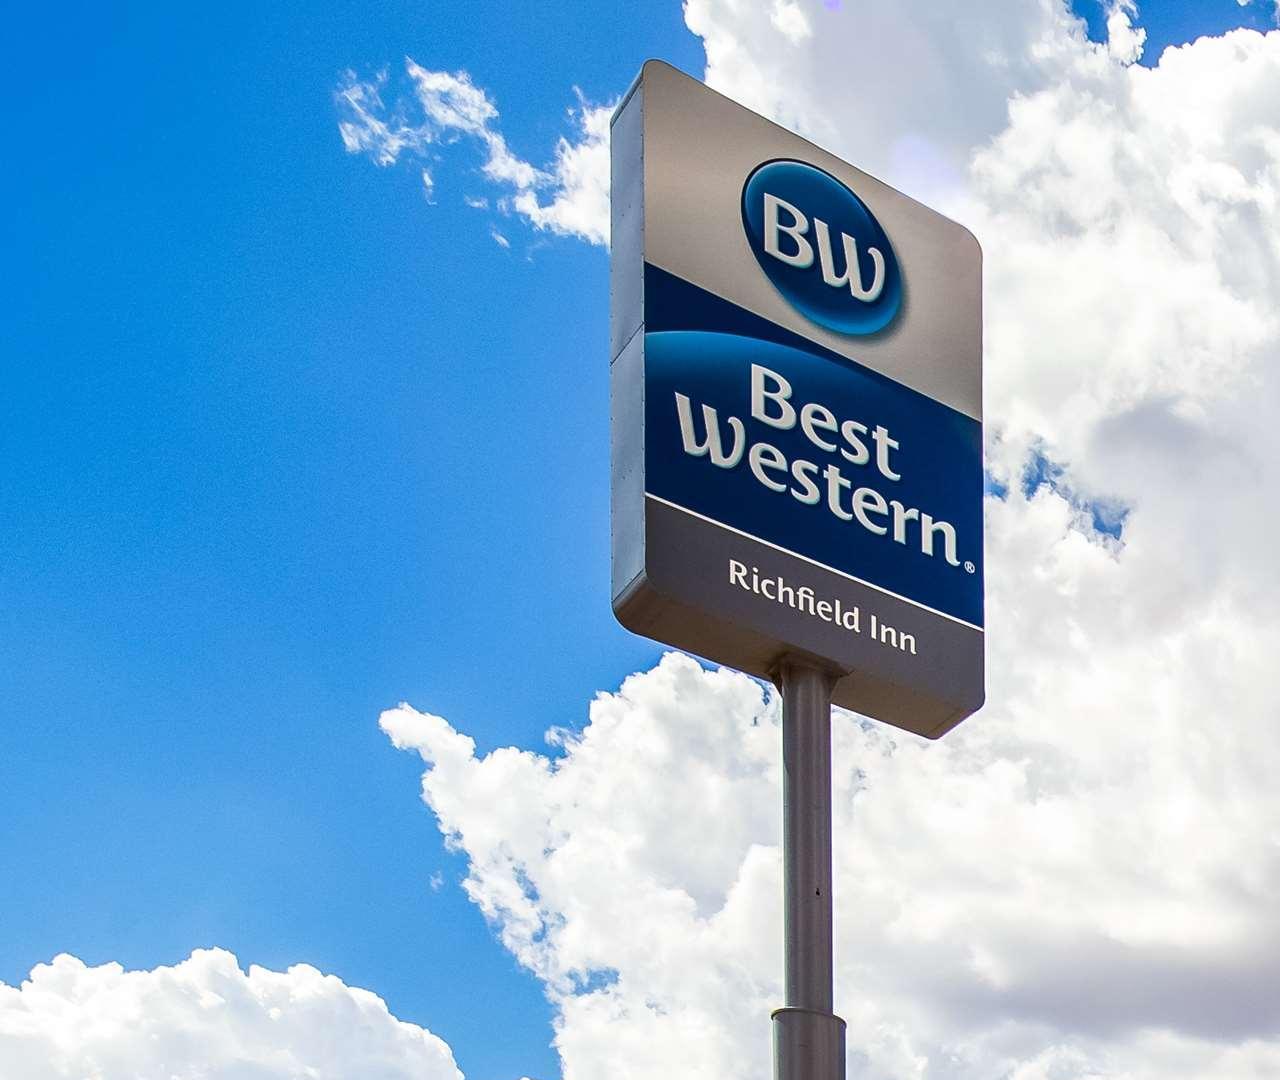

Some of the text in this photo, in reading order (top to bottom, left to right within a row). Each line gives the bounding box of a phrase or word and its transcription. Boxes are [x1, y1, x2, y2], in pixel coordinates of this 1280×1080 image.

[764, 192, 886, 302] BW
[751, 363, 901, 481] Best
[729, 559, 917, 655] Richfield Inn
